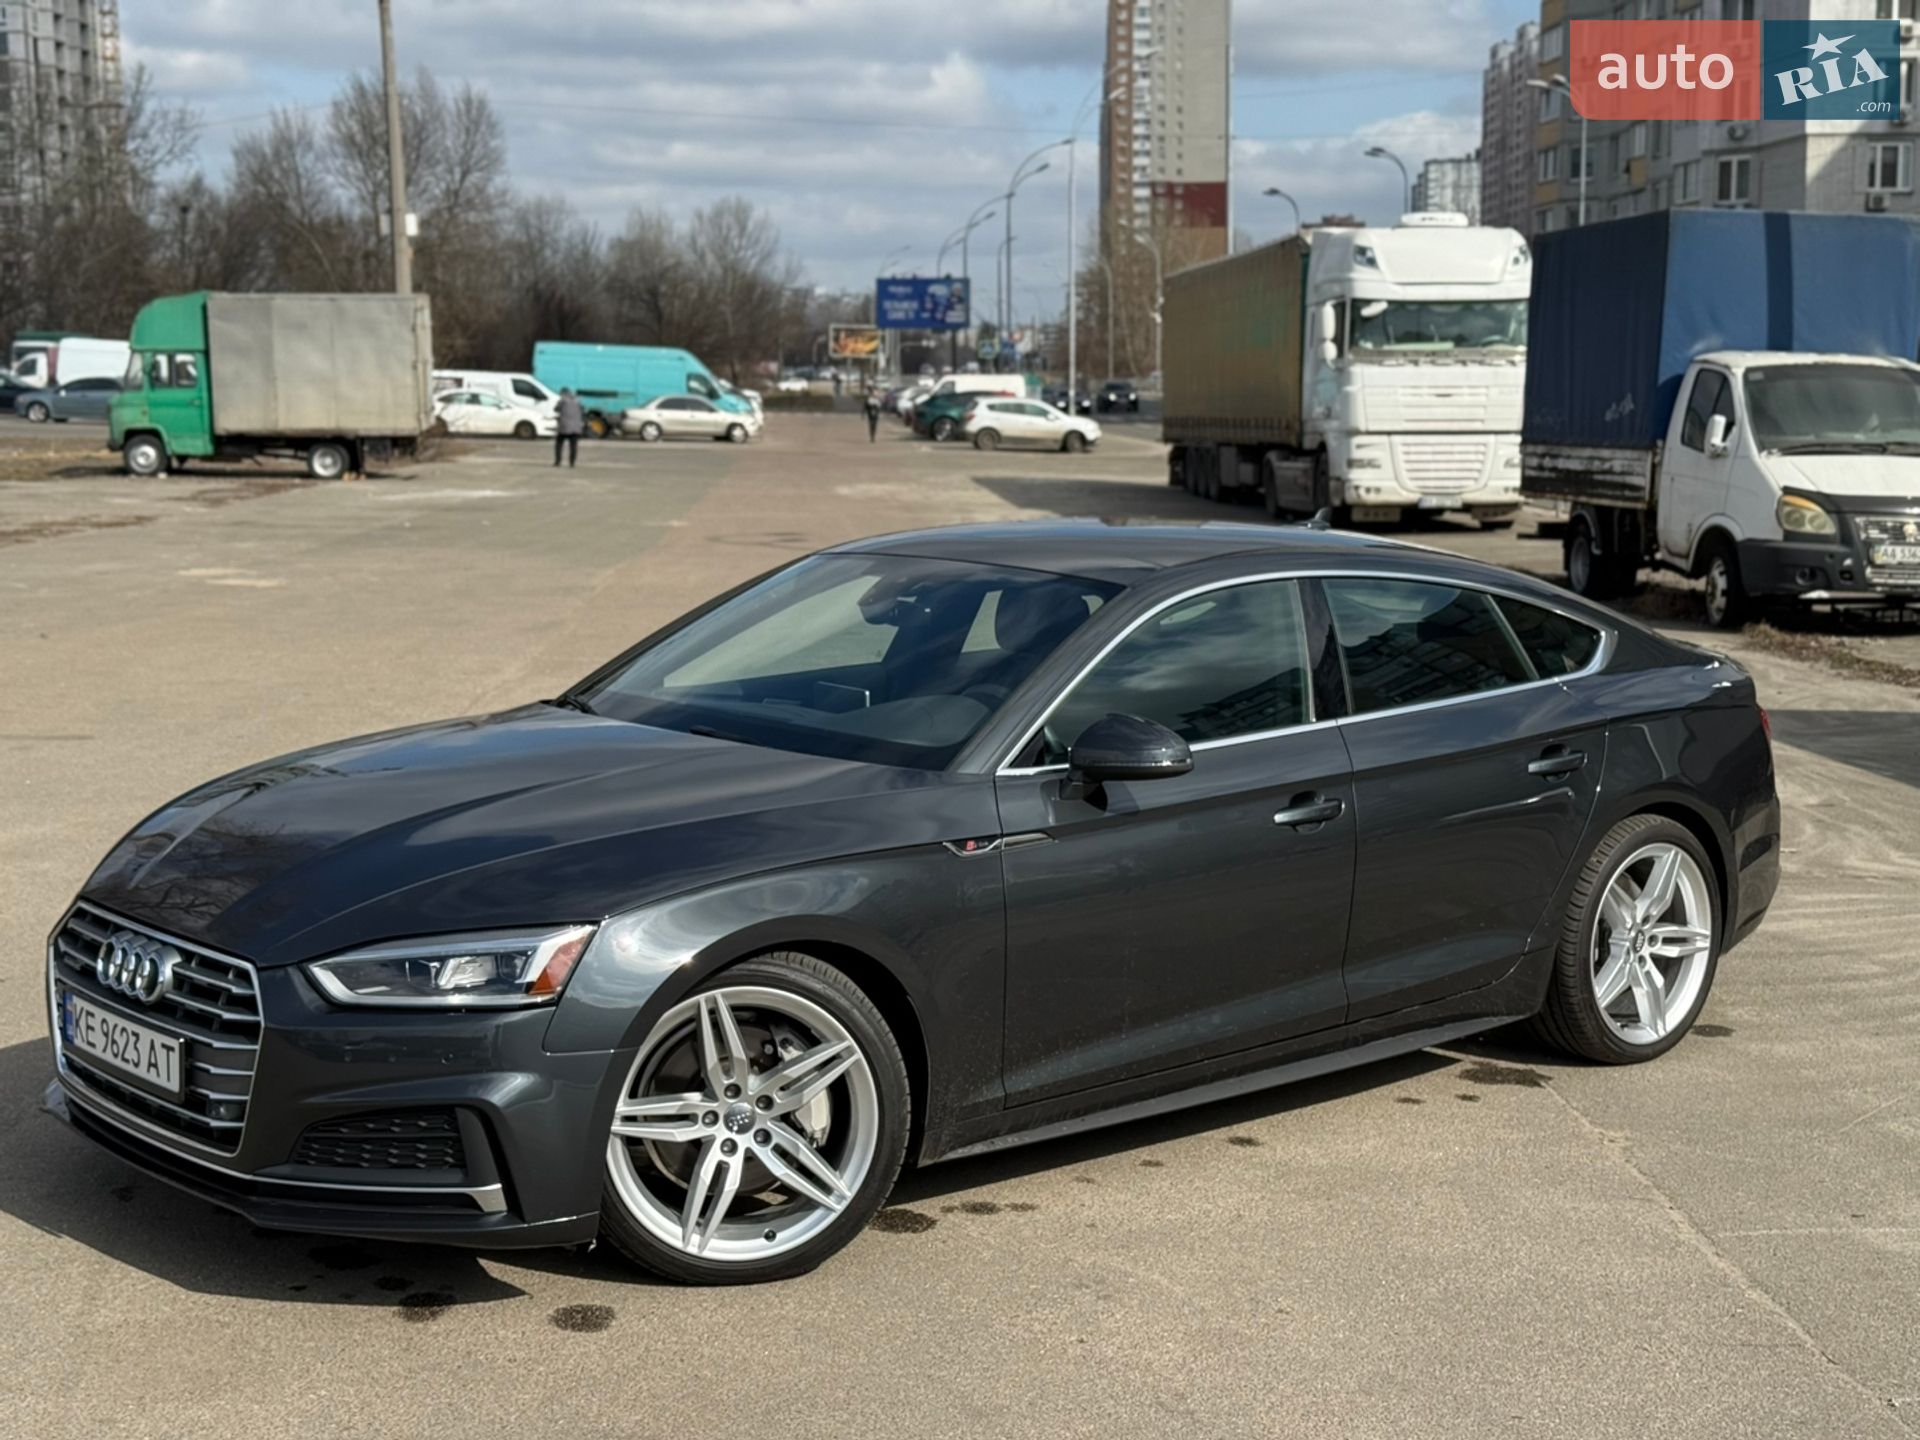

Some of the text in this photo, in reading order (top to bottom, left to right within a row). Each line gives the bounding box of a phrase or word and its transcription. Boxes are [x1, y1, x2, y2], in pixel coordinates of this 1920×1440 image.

[74, 1003, 176, 1083] KE 9623 AT
